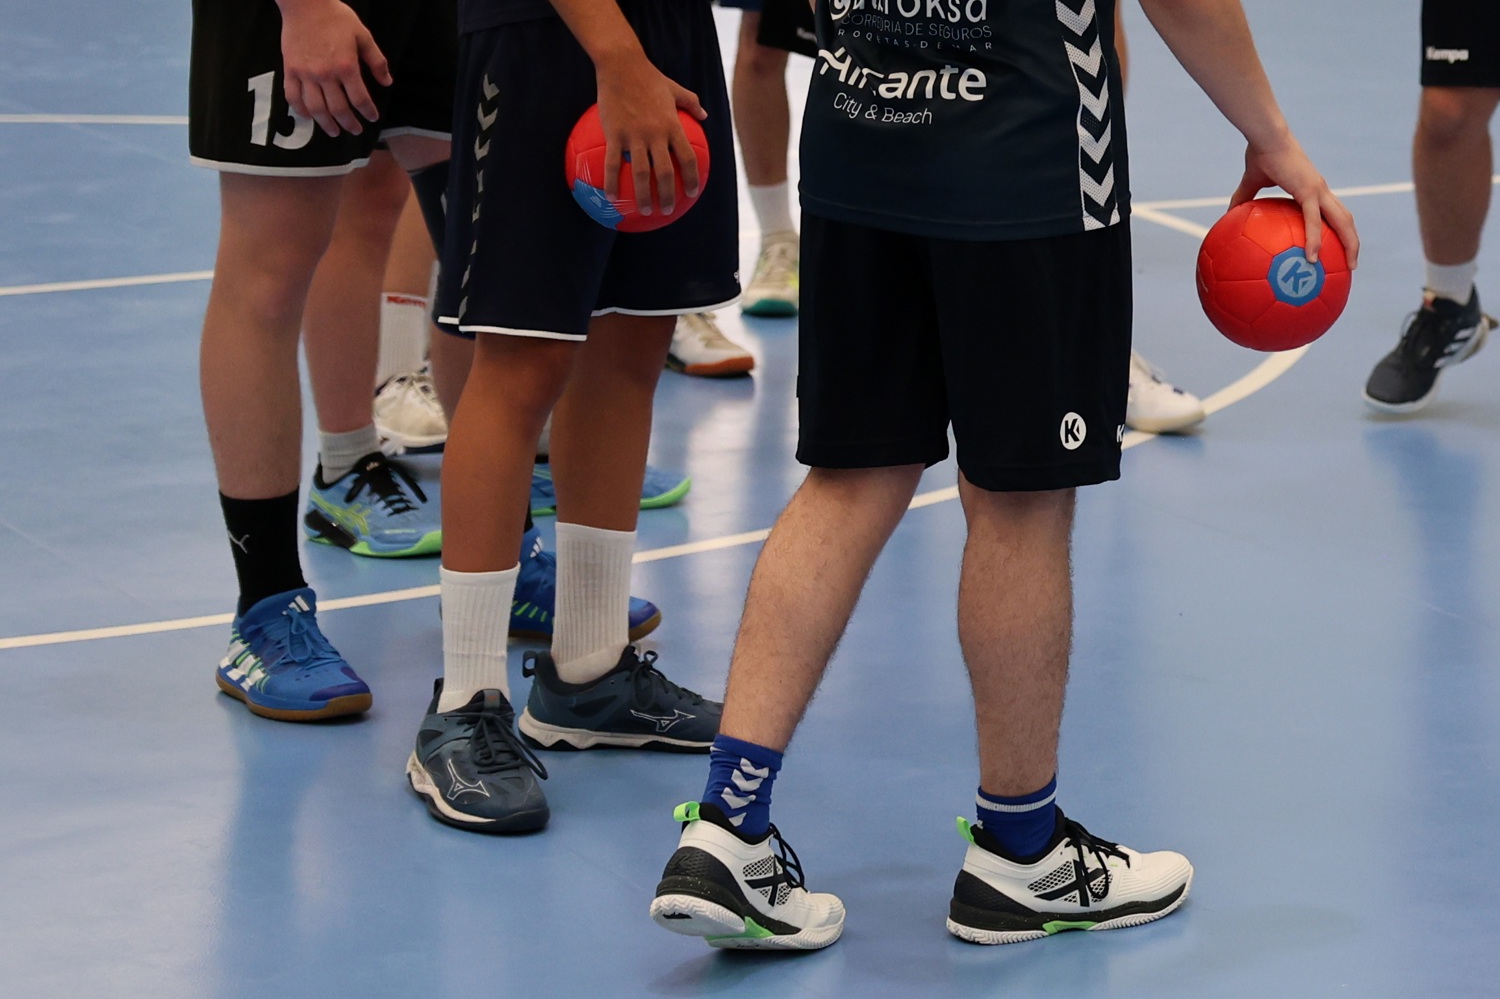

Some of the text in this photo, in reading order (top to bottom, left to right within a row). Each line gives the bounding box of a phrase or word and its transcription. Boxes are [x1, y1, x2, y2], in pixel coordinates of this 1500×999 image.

[905, 22, 924, 36] DE
[928, 23, 993, 41] SEGUROS
[833, 92, 933, 125] City & Beach
